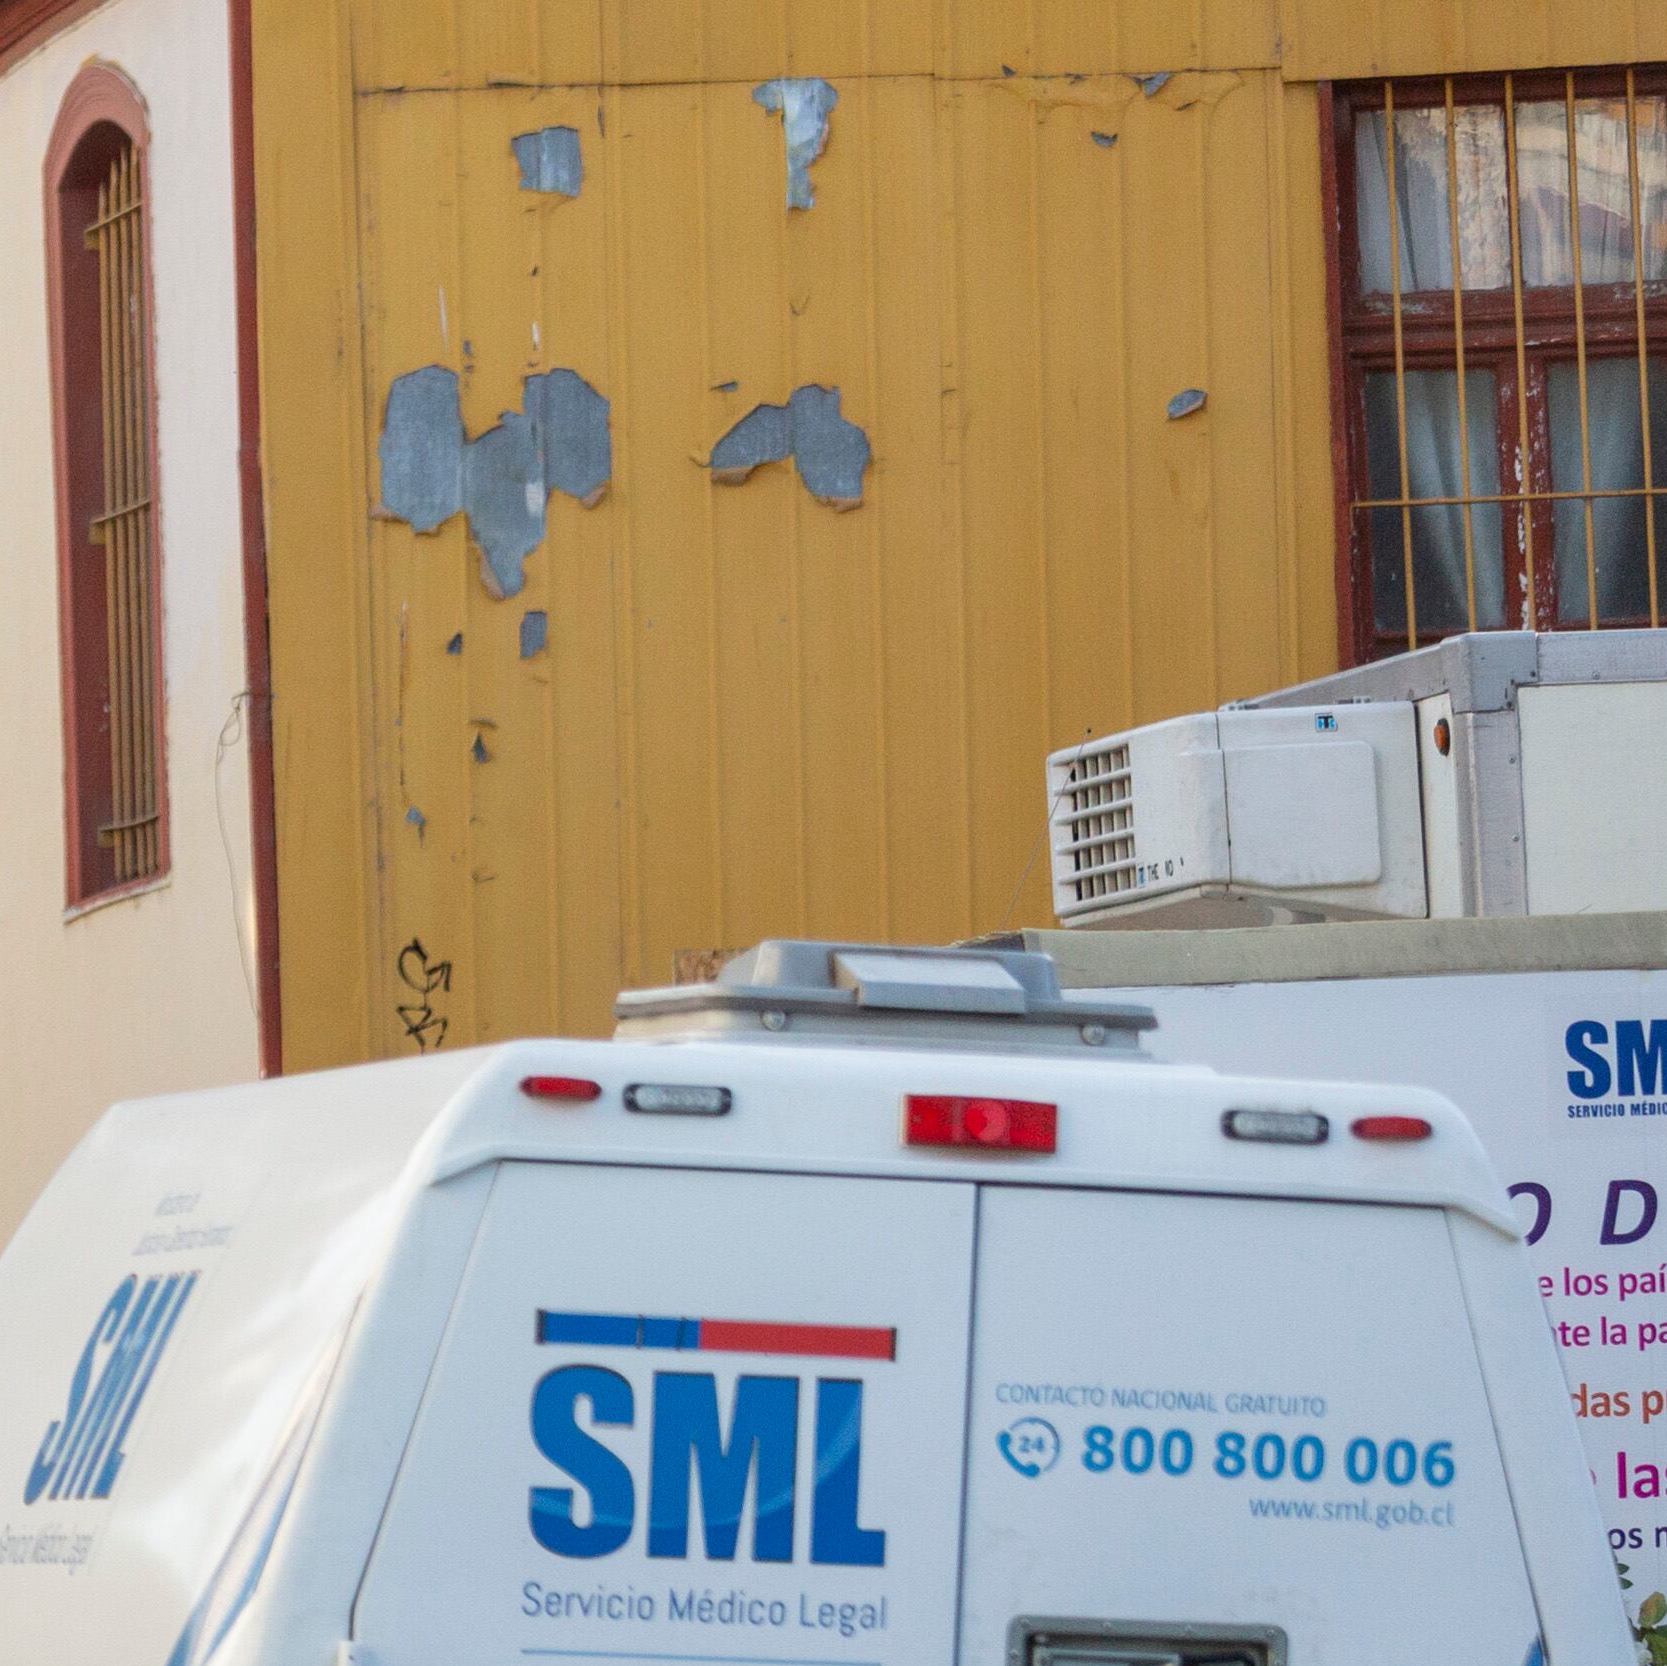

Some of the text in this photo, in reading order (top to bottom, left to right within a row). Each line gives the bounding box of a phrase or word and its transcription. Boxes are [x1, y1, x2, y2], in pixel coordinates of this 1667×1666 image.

[1567, 1103, 1625, 1119] SERVICIO
[1563, 1267, 1609, 1297] los
[1551, 1320, 1591, 1348] te
[1600, 1316, 1628, 1346] la
[22, 1269, 203, 1506] SML
[994, 1381, 1329, 1418] CONTACTO NACIONAL GRATUITO
[527, 1362, 887, 1568] SML
[1018, 1423, 1456, 1488] 24 800 800 006
[1616, 1450, 1667, 1500] la
[1248, 1496, 1455, 1529] www.sml.gob.cl
[520, 1579, 889, 1638] Servicio Médico Legal
